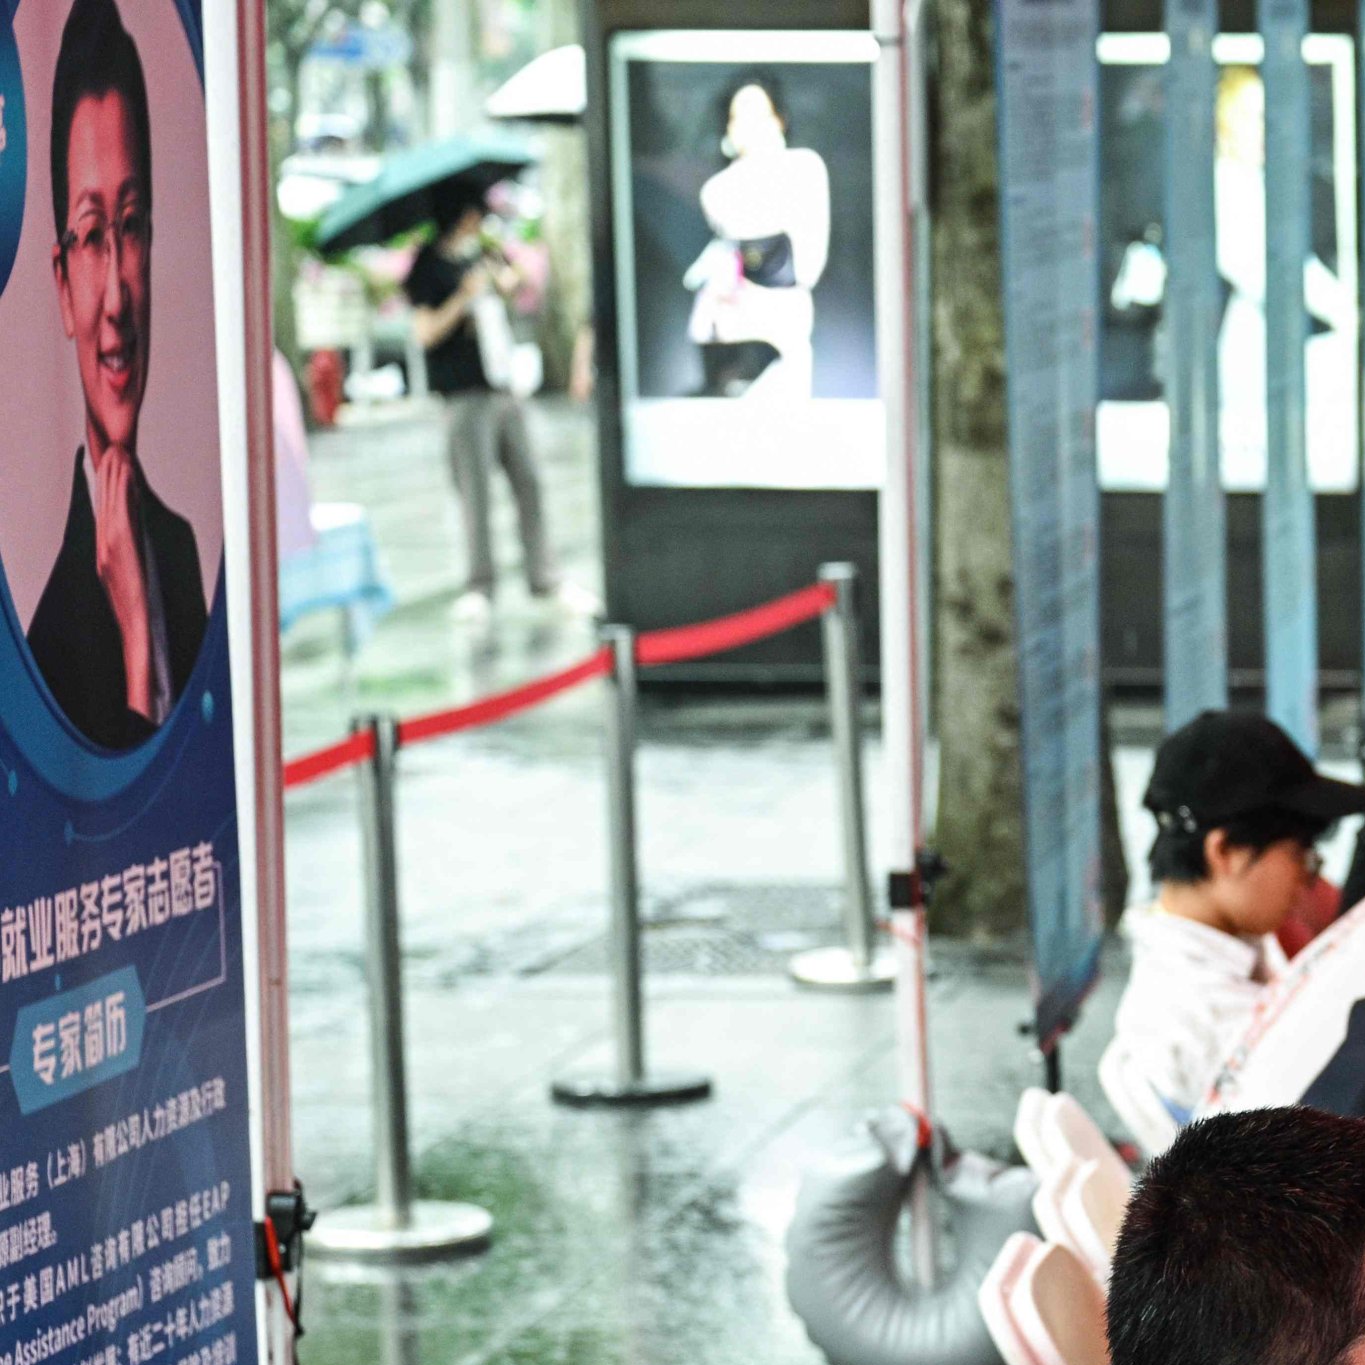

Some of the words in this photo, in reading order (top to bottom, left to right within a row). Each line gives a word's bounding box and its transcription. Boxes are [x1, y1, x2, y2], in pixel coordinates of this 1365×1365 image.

[1, 841, 216, 984] 就业服务专家志愿者
[32, 991, 127, 1085] 专家简历
